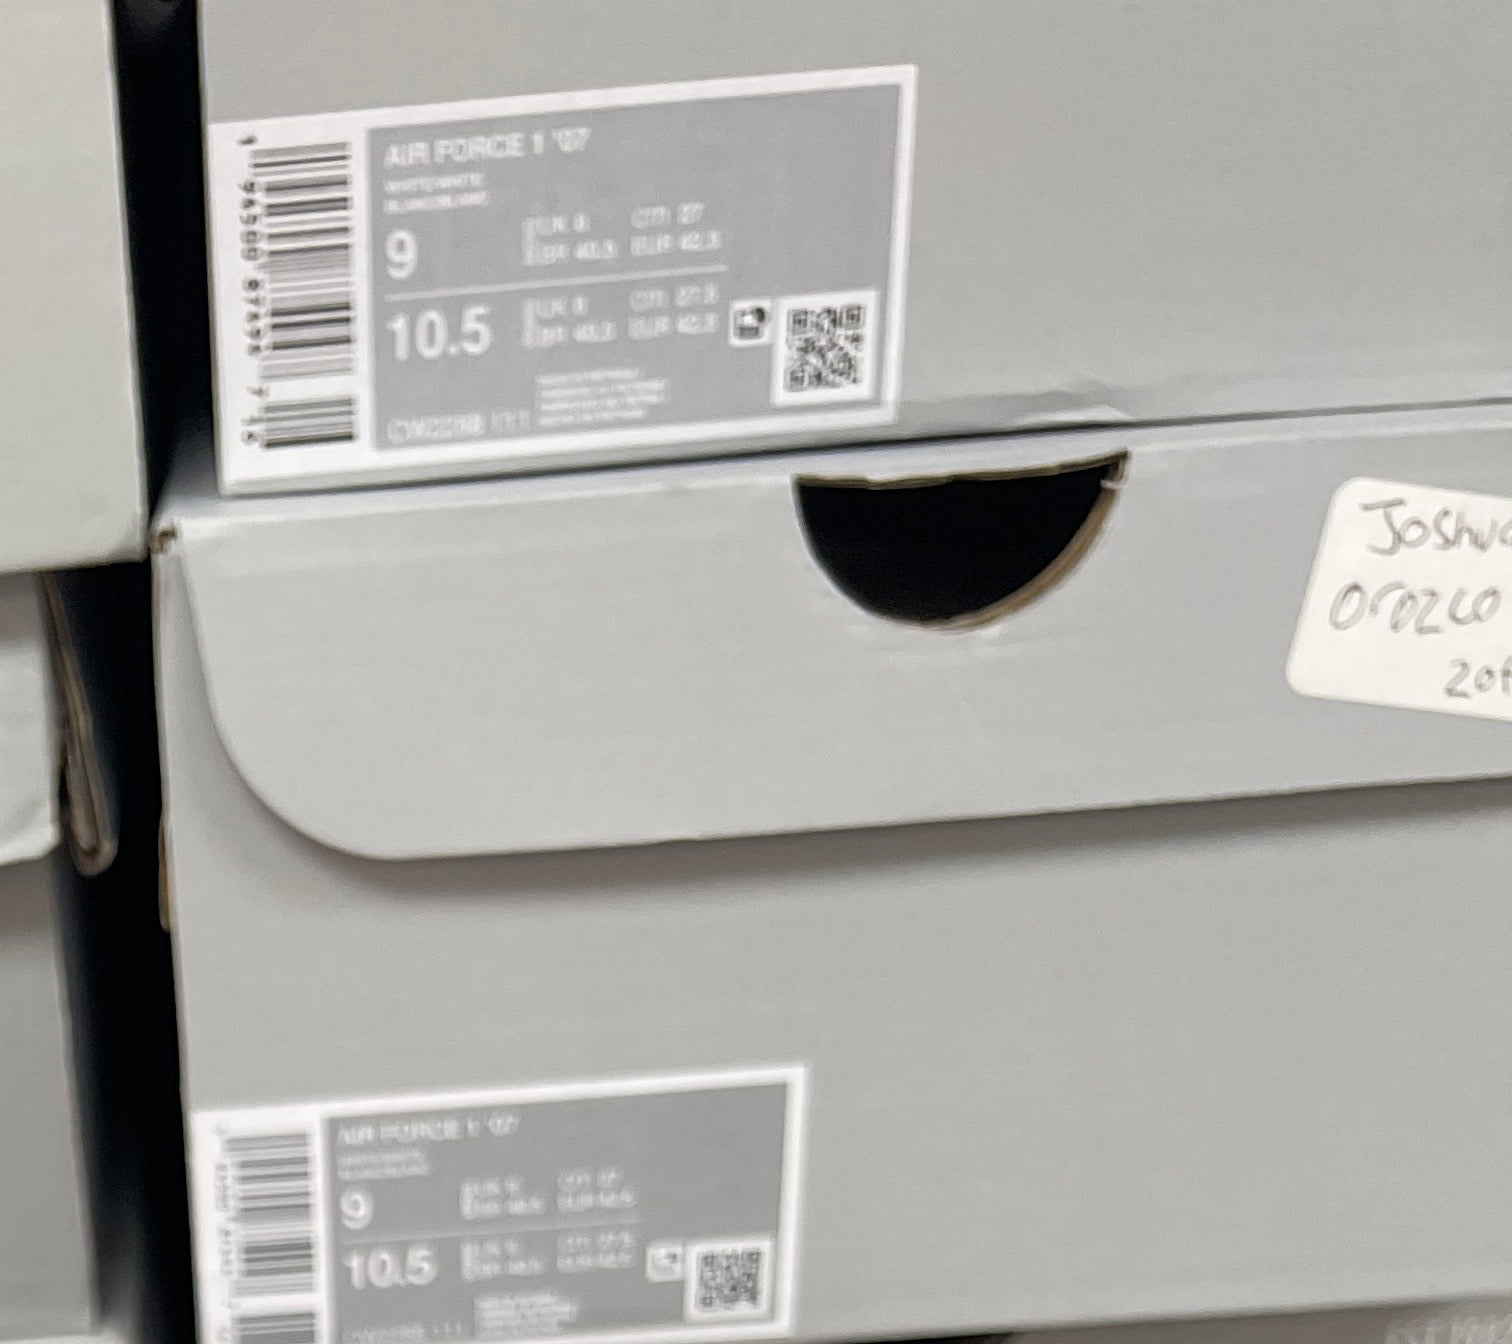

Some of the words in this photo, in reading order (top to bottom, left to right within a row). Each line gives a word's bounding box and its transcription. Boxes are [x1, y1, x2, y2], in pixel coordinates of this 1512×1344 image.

[383, 141, 430, 168] AIR
[434, 132, 526, 163] FORCE
[385, 228, 418, 280] 9
[384, 305, 492, 362] 10.5
[340, 1186, 373, 1231] 9
[343, 1244, 438, 1291] 10.5
